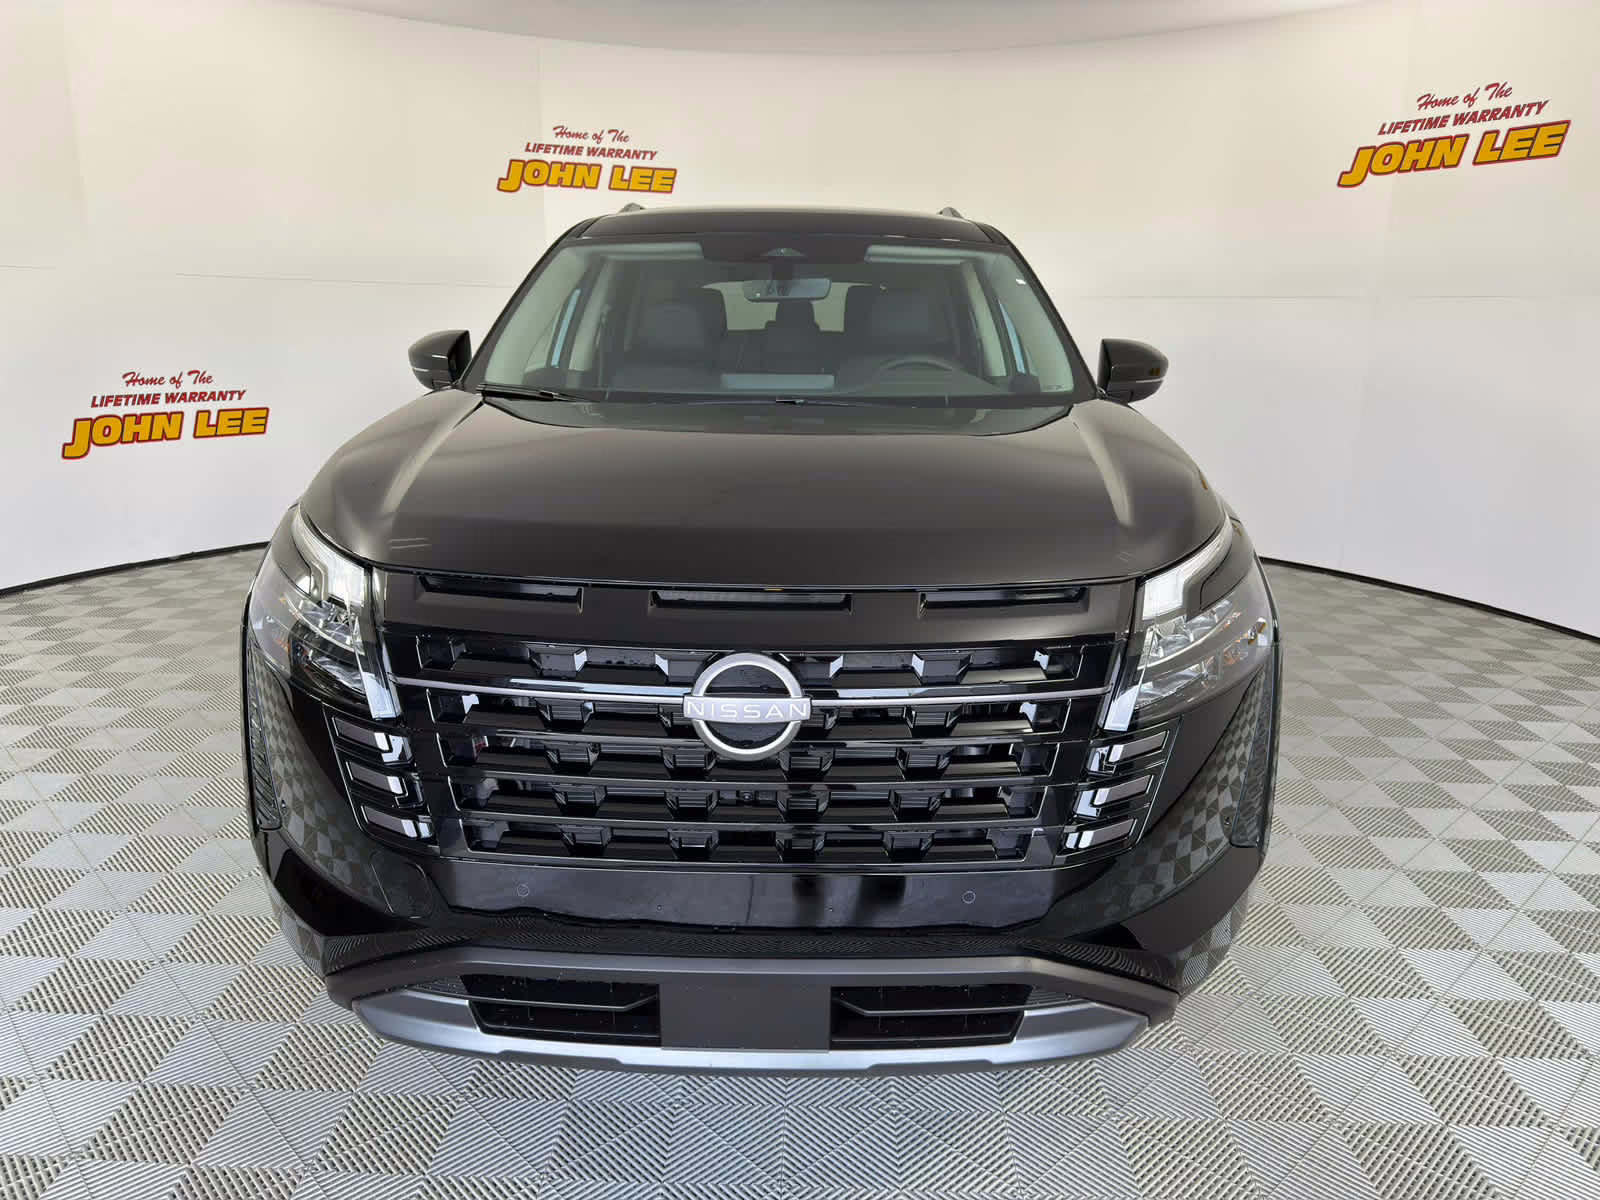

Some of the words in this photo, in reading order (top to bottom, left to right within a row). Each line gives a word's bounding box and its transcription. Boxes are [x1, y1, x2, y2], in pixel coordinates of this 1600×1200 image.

[1416, 93, 1459, 111] Home
[1463, 87, 1480, 109] of
[1484, 81, 1513, 100] The
[1377, 115, 1450, 136] LIFETIME
[1452, 100, 1549, 127] WARRANTY
[553, 125, 588, 140] Home
[591, 130, 604, 144] of
[607, 129, 629, 143] The
[525, 142, 584, 156] LIFETIME
[587, 146, 657, 160] WARRANTY
[1337, 133, 1470, 188] JOHN
[1472, 119, 1572, 166] LEE
[496, 159, 602, 193] JOHN
[608, 165, 677, 194] LEE
[122, 371, 165, 387] Home
[169, 372, 183, 389] of
[187, 369, 213, 385] The
[91, 393, 160, 408] LIFETIME
[165, 389, 246, 404] WARRANTY
[61, 411, 184, 460] JOHN
[193, 407, 270, 439] LEE
[686, 701, 808, 719] NISSAN
